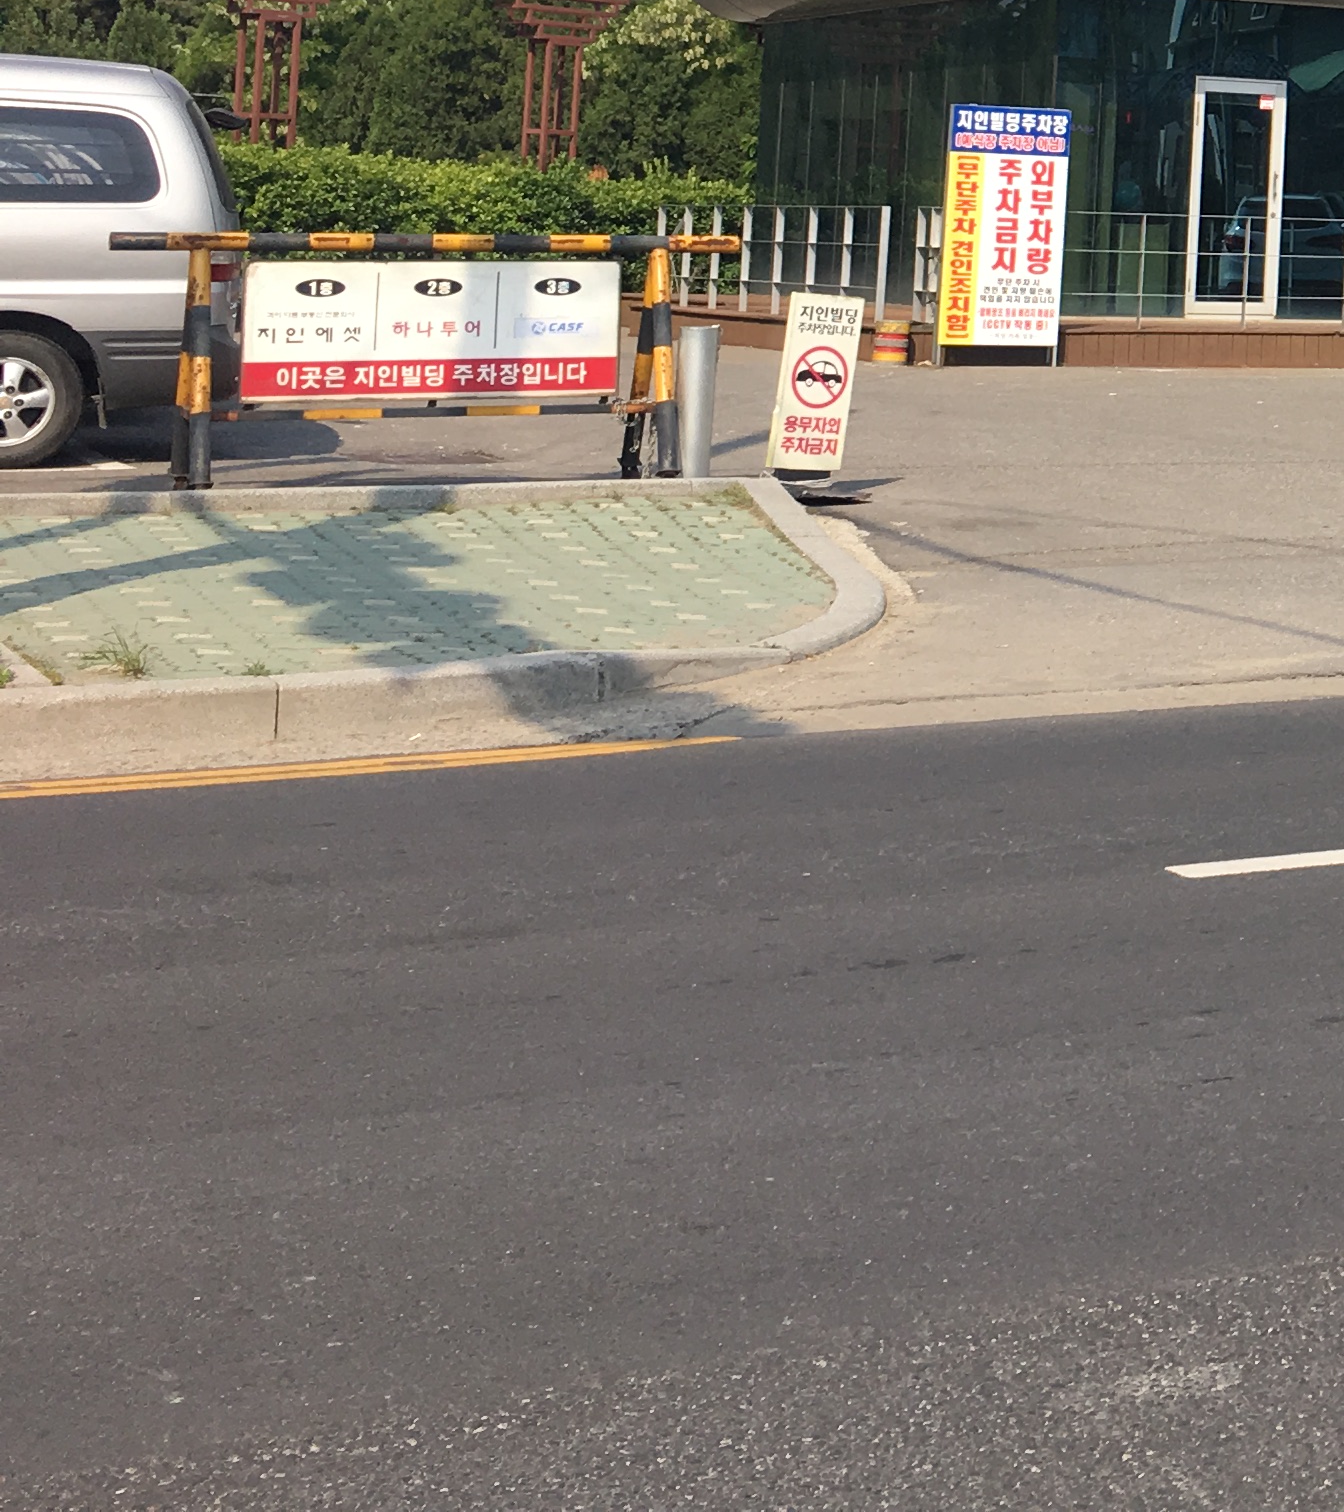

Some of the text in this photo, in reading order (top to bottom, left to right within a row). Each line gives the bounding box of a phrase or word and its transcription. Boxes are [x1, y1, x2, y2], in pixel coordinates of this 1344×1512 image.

[956, 109, 1069, 135] 지인빌딩주차장
[991, 158, 1022, 274] 주차금지
[1026, 159, 1055, 276] 외부차량
[308, 281, 334, 296] 1층
[427, 280, 451, 295] 2층
[546, 280, 570, 294] 3층
[800, 305, 859, 324] 지인빌딩
[257, 326, 362, 344] 지인에셋
[391, 320, 482, 338] 하나투어
[276, 361, 588, 390] 이곳은 지인빌딩 주차장입니다
[780, 436, 839, 456] 주차금지
